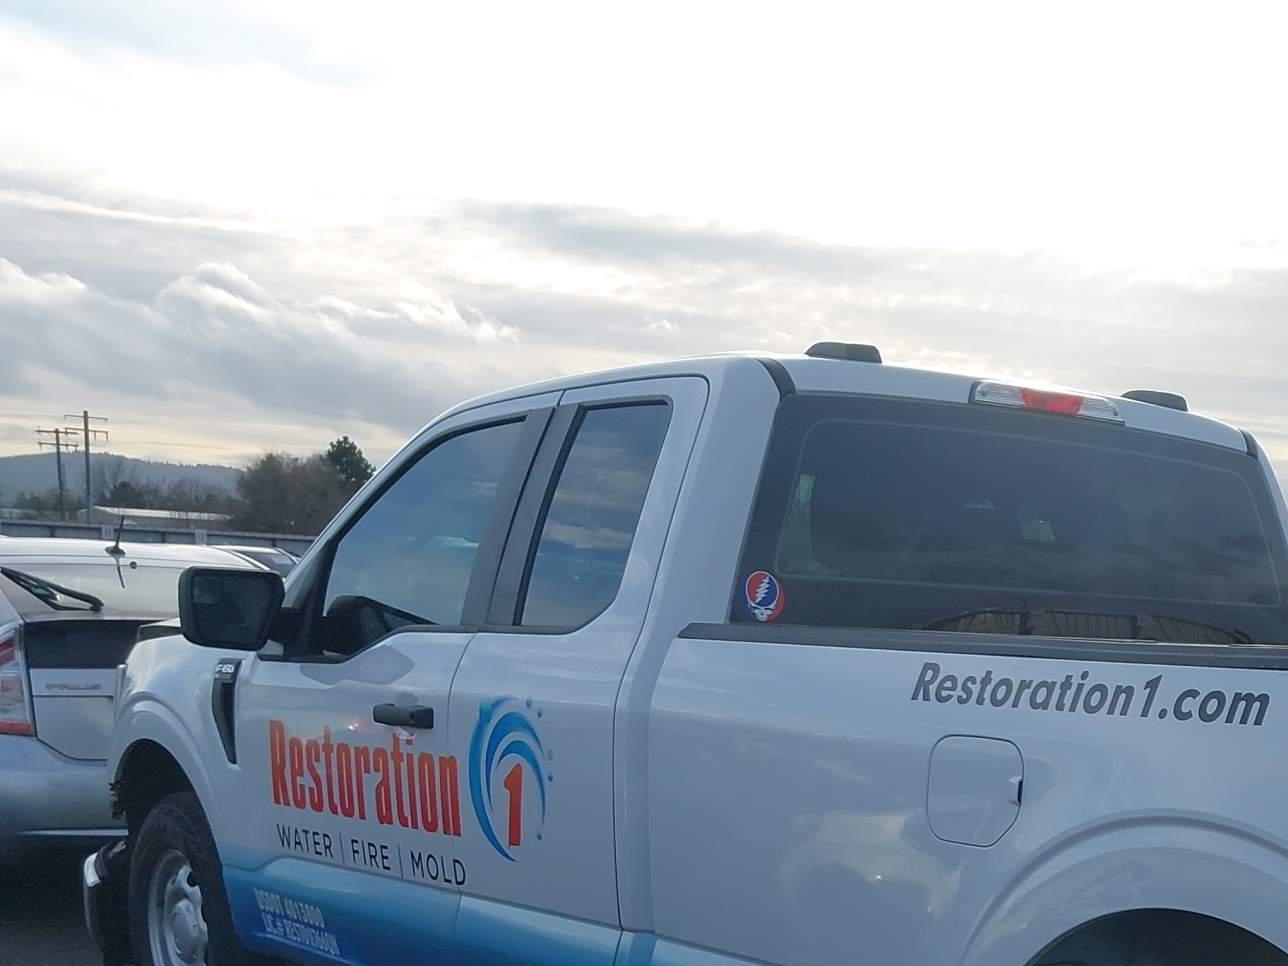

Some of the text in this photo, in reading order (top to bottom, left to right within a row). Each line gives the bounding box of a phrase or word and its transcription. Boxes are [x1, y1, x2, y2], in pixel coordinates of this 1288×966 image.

[911, 661, 1271, 726] Restoration1.com
[269, 719, 523, 848] Restoration 1
[275, 823, 467, 886] WATER FIRE MOLD
